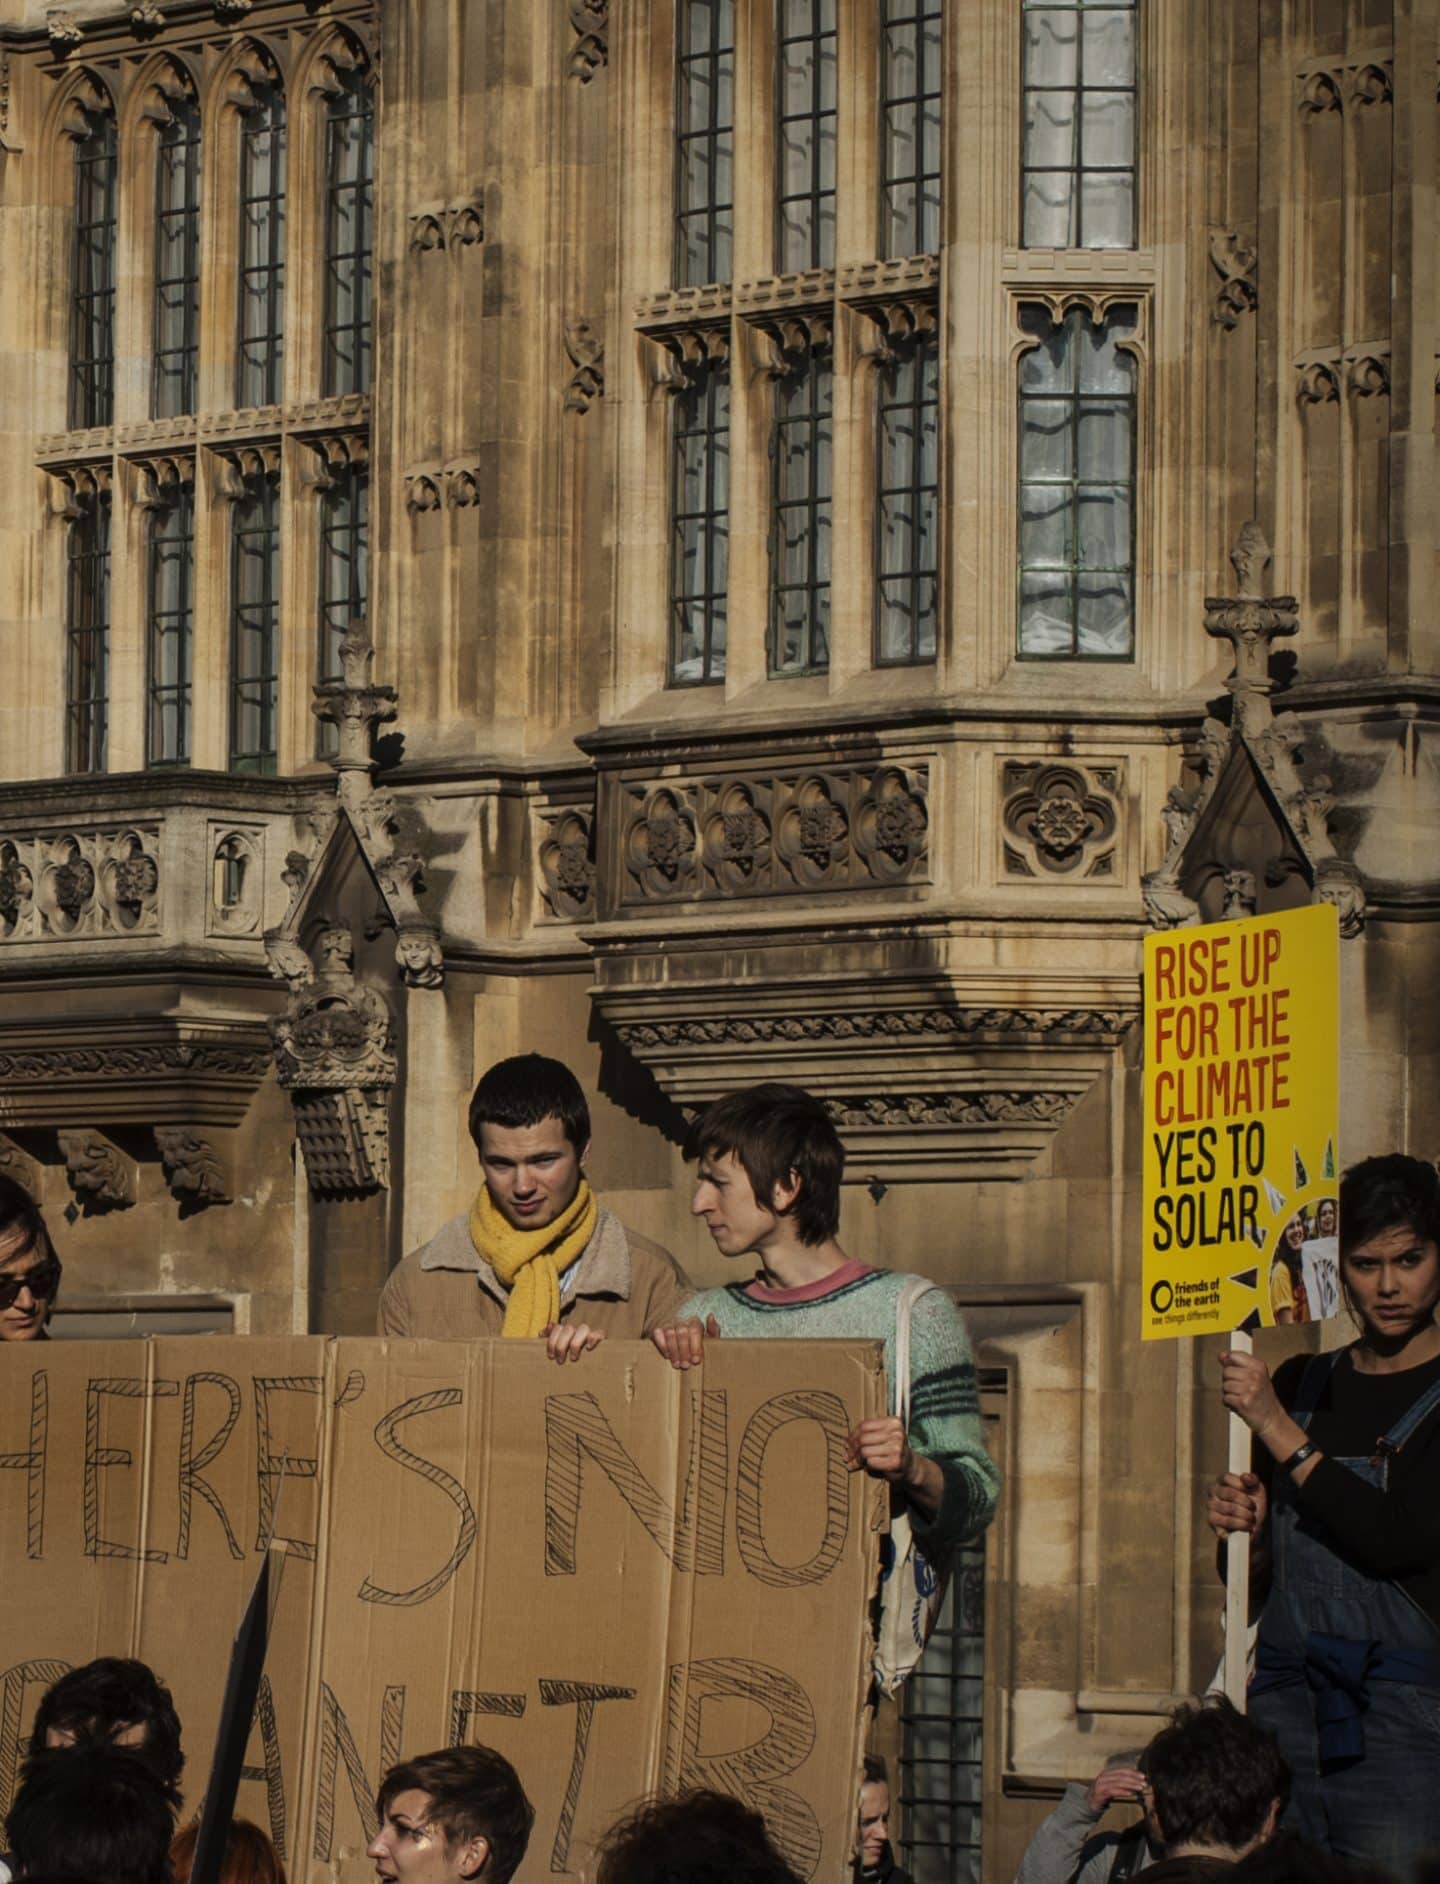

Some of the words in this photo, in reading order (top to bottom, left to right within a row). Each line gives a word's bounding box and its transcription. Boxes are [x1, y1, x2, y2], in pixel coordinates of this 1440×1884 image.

[1154, 935, 1231, 1002] RISE
[1240, 928, 1282, 990] UP
[1154, 1001, 1220, 1065] FOR
[1228, 988, 1291, 1052] THE
[1154, 1052, 1291, 1128] CLIMATE
[1153, 1126, 1216, 1188] YES
[1226, 1120, 1265, 1179] TO
[1153, 1184, 1263, 1252] SOLAR
[1175, 1280, 1209, 1295] friends
[1210, 1277, 1220, 1290] of
[1175, 1296, 1192, 1308] the
[1194, 1292, 1220, 1307] earth
[545, 1388, 851, 1588] NO
